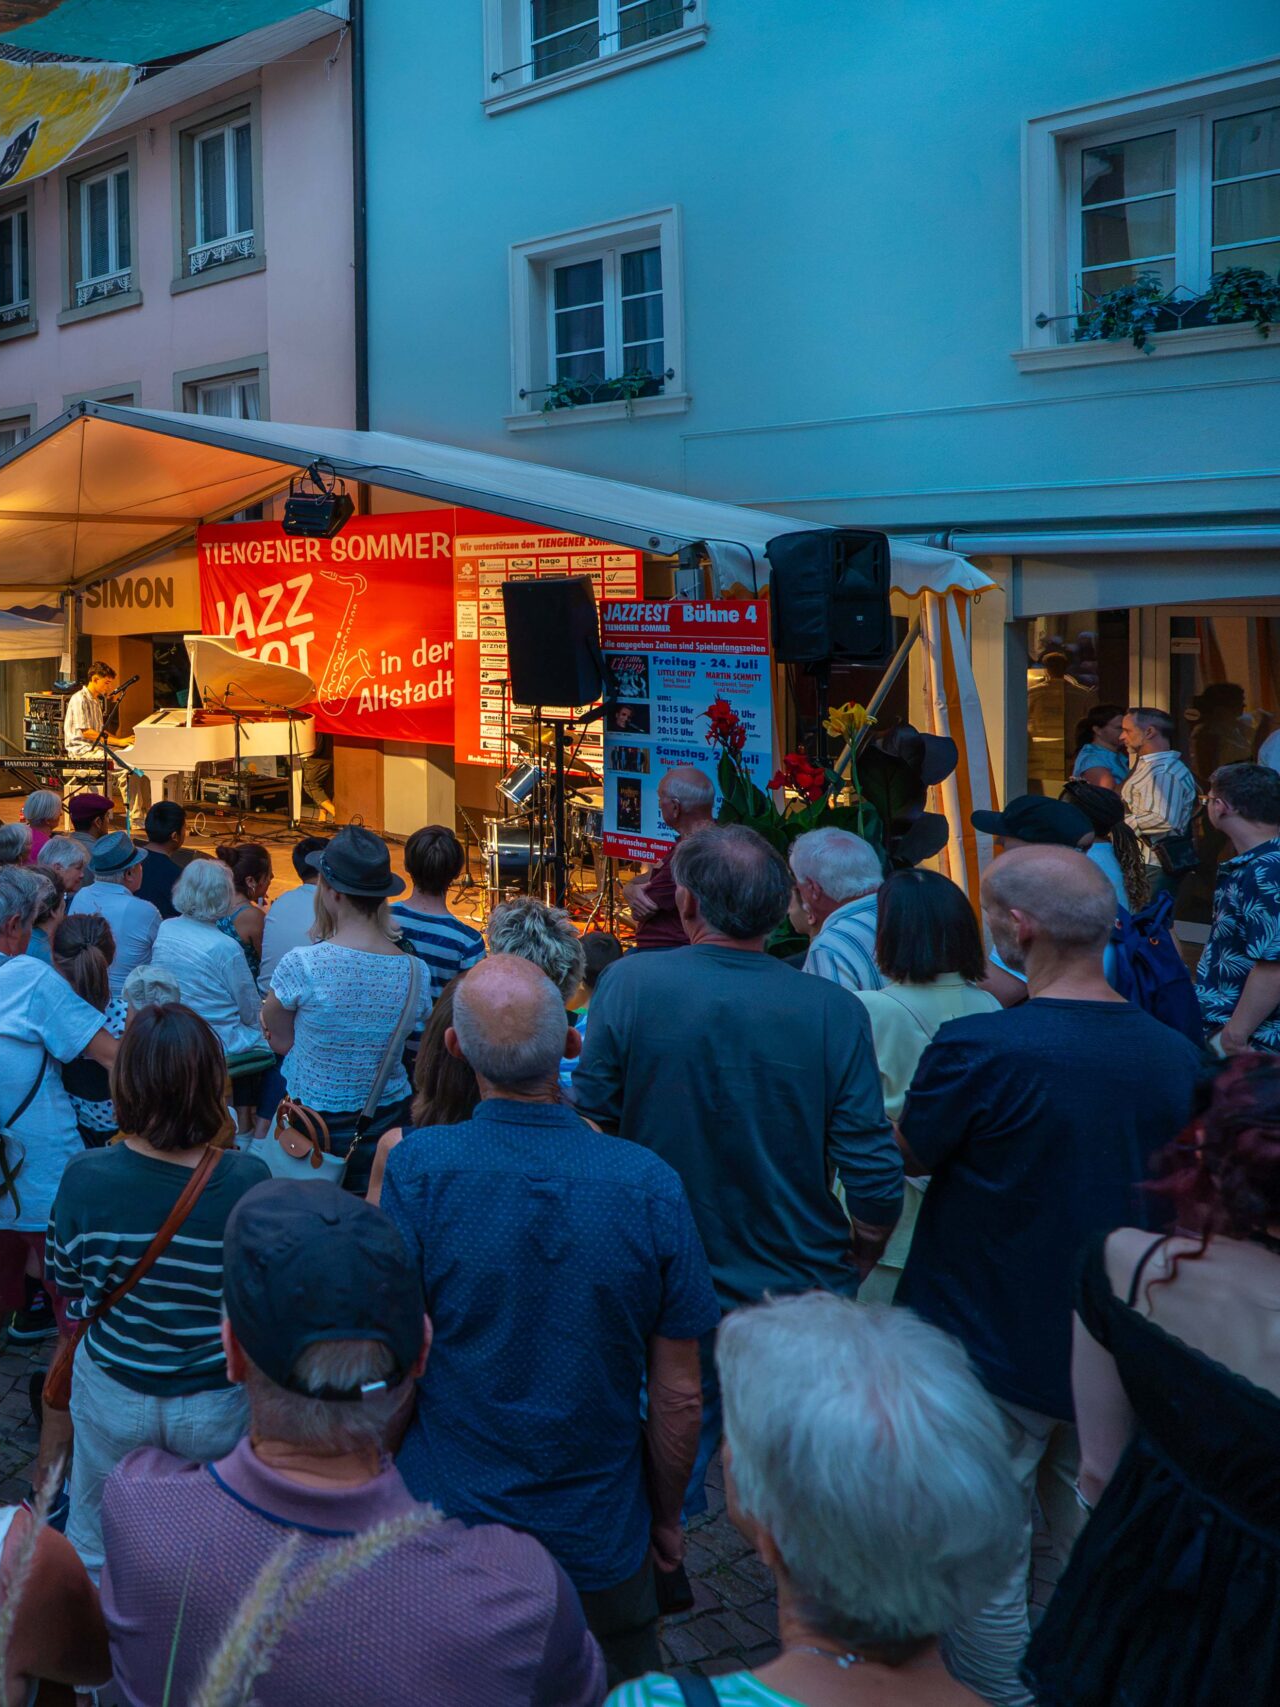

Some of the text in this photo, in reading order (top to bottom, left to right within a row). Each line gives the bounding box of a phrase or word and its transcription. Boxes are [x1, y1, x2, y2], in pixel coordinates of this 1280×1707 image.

[202, 532, 452, 565] TIENGENER SOMMER
[459, 543, 472, 552] Wir
[474, 541, 519, 552] unterstützen
[521, 539, 536, 550] den
[537, 536, 585, 549] TIENGENER
[540, 558, 560, 566] hago
[86, 577, 174, 608] SIMON
[216, 573, 314, 640] JAZZ
[603, 602, 757, 623] JAZZFEST Bühne 4
[604, 624, 671, 632] TIENGENER SOMMER
[604, 640, 766, 653] die angegeben Zeiten sind Spielanfangszeiten
[381, 637, 454, 675] in der
[653, 656, 697, 669] Freitag
[710, 658, 730, 669] 24.
[734, 659, 758, 670] Juli
[677, 670, 696, 678] CHEVY
[706, 672, 762, 681] MARTIN SCHMITT
[357, 669, 454, 715] Altstadt
[657, 704, 694, 714] 18:15 Uhr
[741, 710, 756, 719] Uhr
[657, 716, 694, 726] 19:15 Uhr
[657, 726, 694, 737] 20:15 Uhr
[656, 745, 709, 762] Samstag,
[743, 754, 760, 765] uli
[606, 835, 668, 851] Wir wünschen einen
[628, 848, 655, 859] TIENGEN
